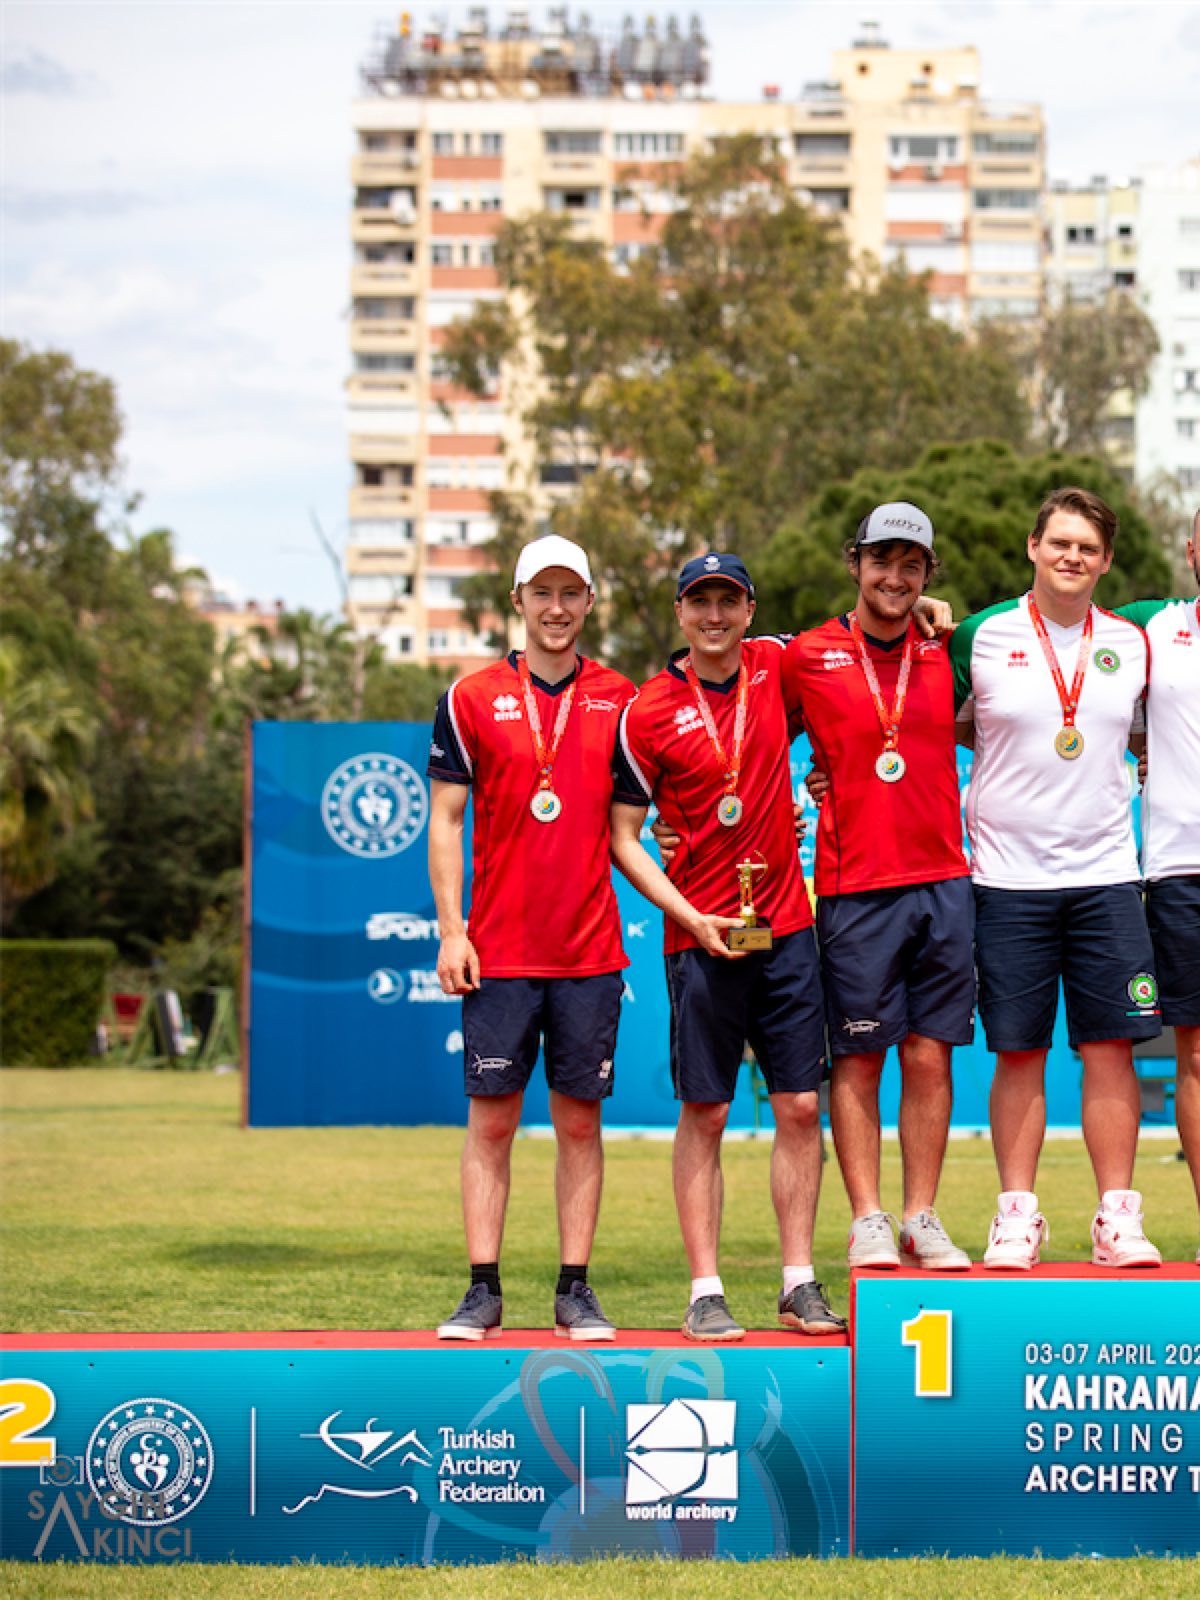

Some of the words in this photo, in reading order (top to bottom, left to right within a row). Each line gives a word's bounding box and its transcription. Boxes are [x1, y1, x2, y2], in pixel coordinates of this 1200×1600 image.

[901, 1309, 953, 1397] 1
[1025, 1343, 1089, 1365] 03-07
[1097, 1344, 1157, 1365] APRIL
[0, 1378, 57, 1467] 2
[438, 1427, 515, 1449] Turkish
[1025, 1422, 1183, 1453] SPRING
[438, 1453, 521, 1480] Archery
[1025, 1464, 1178, 1493] ARCHERY
[439, 1479, 545, 1503] Federation
[626, 1504, 672, 1520] world
[675, 1504, 738, 1522] archery
